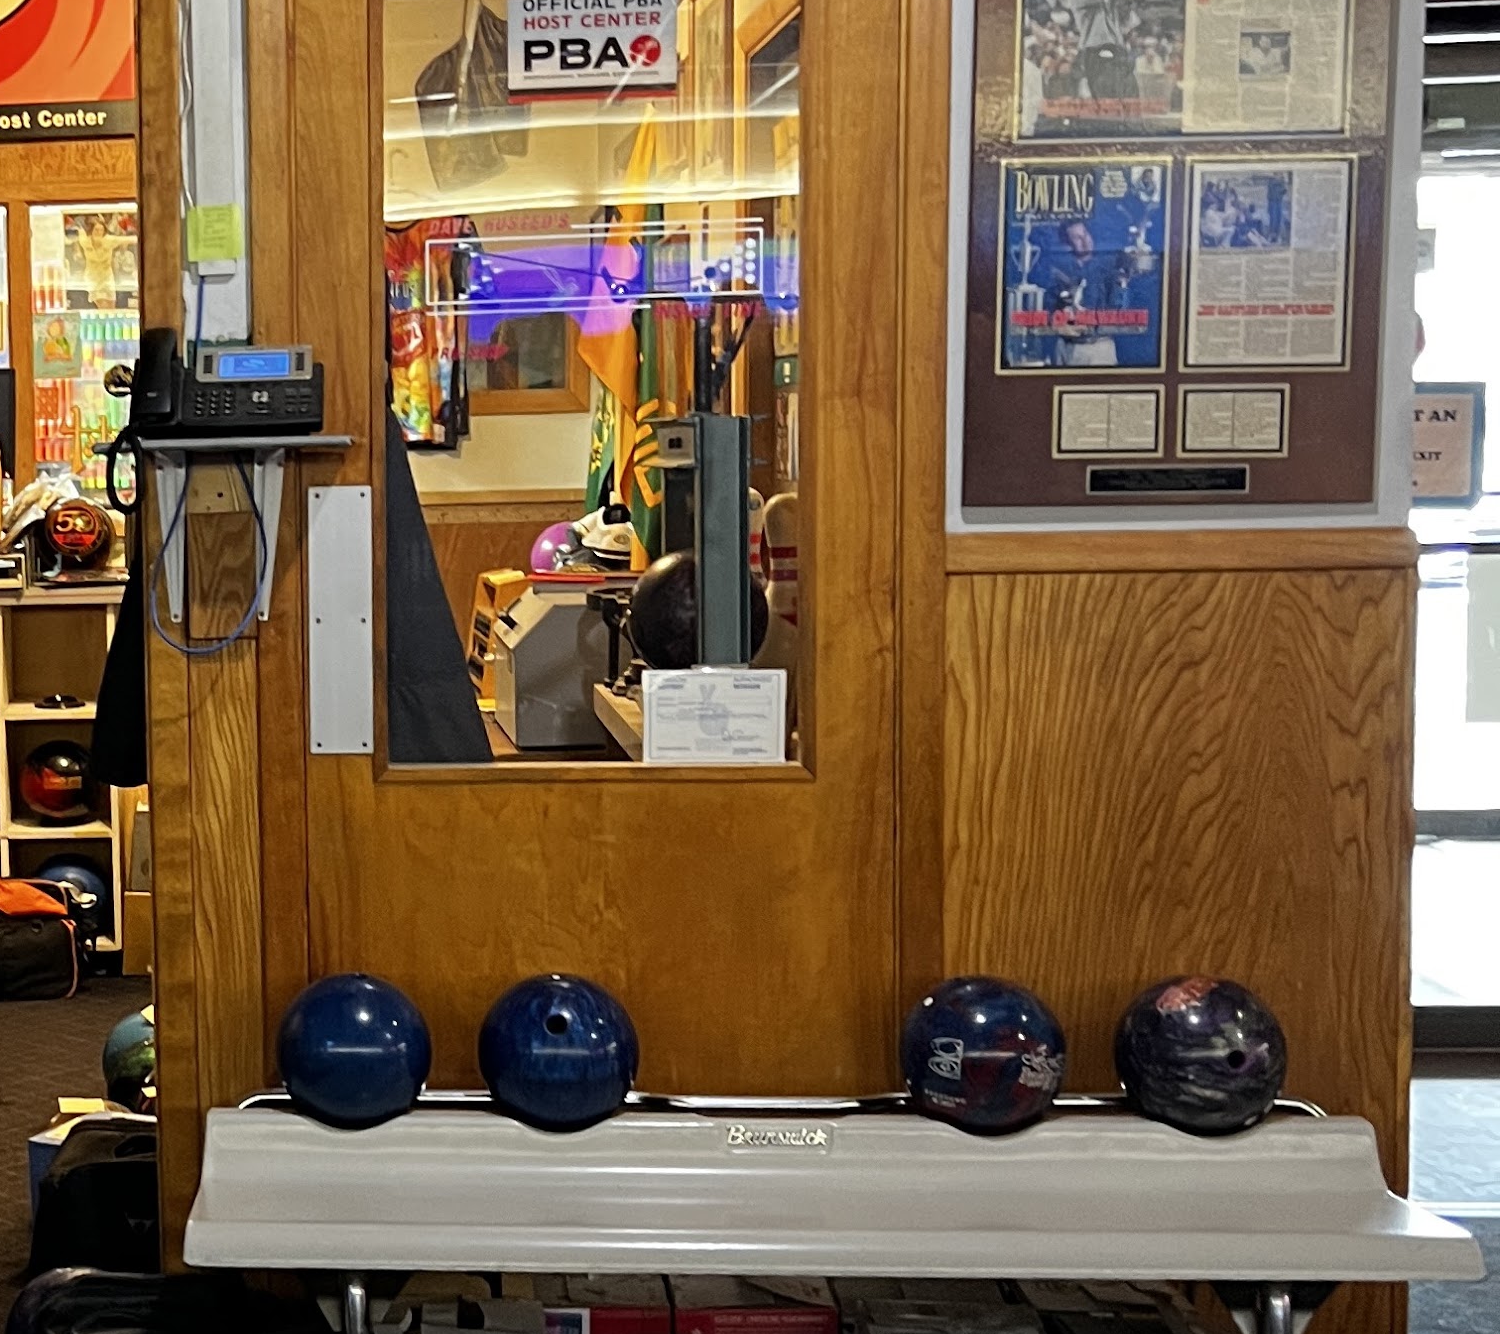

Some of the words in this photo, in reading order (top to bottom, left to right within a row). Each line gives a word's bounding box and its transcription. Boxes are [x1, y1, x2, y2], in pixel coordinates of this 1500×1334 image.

[524, 15, 572, 30] HOST
[581, 11, 662, 28] CENTER
[523, 36, 631, 72] PBA
[38, 109, 107, 127] Center
[1016, 171, 1094, 214] BOWLING
[1428, 410, 1457, 422] AN
[726, 1124, 828, 1145] Brunswick
